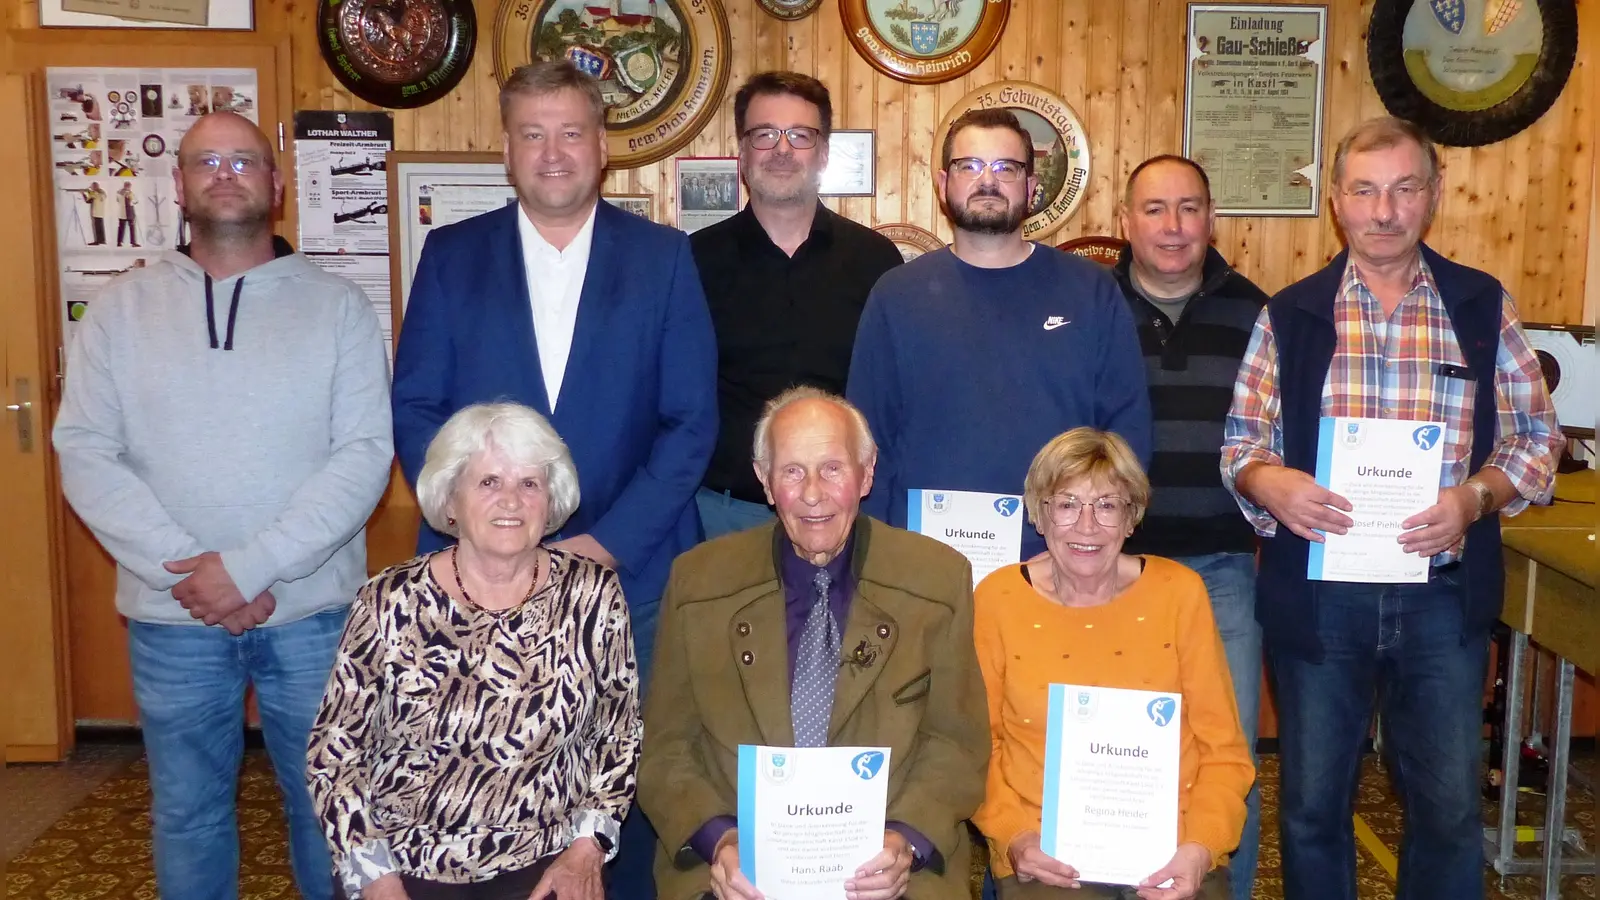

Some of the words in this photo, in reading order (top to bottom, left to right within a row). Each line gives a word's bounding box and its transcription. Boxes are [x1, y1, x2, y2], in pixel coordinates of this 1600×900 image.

[1230, 16, 1284, 33] Einladung
[915, 50, 972, 76] Heinrich
[1234, 79, 1243, 87] in
[1248, 78, 1276, 88] Kastl
[977, 92, 997, 110] 75.
[1000, 87, 1074, 135] Geburtstag
[307, 129, 339, 137] LOTHAR
[340, 129, 378, 137] WALTHER
[1053, 167, 1087, 215] Kemmling
[1047, 316, 1064, 325] NIKE
[1357, 466, 1412, 478] Urkunde
[945, 528, 995, 540] Urkunde
[1090, 742, 1149, 758] Urkunde
[787, 802, 853, 816] Urkunde
[1084, 805, 1115, 818] Regina
[791, 866, 816, 875] Hans
[819, 864, 844, 873] Raab
